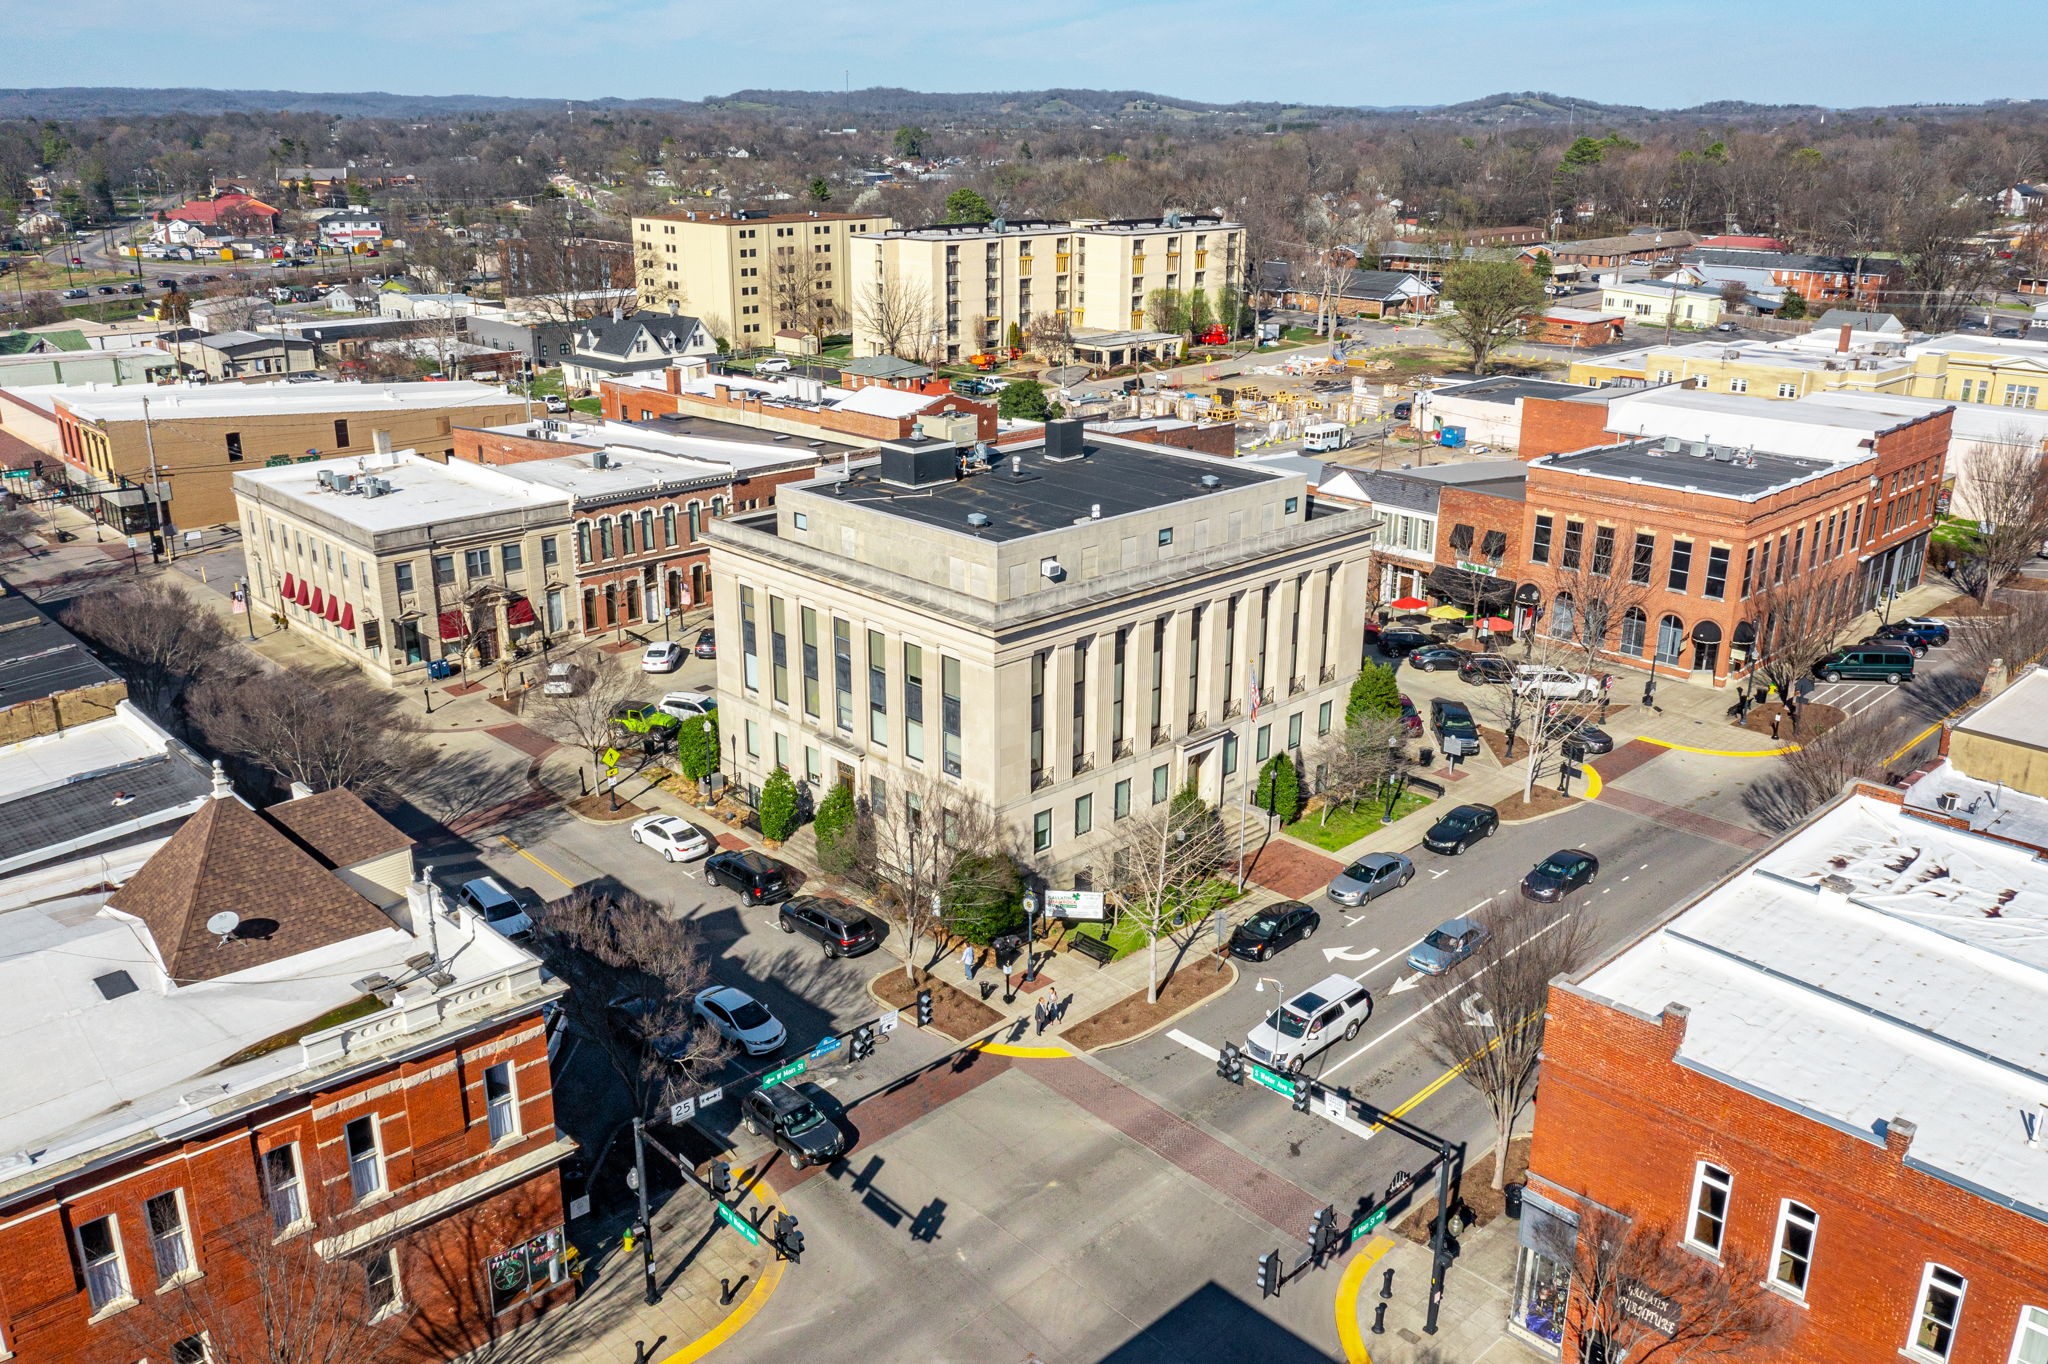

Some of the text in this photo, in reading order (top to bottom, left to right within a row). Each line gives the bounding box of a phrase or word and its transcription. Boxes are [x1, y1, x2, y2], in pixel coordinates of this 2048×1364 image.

[783, 1067, 796, 1077] Main
[797, 1062, 804, 1071] St
[1254, 1069, 1288, 1092] S Water Ave
[675, 1101, 691, 1117] 25
[1353, 1217, 1375, 1238] E Main St
[1628, 1285, 1669, 1312] GALLATIN
